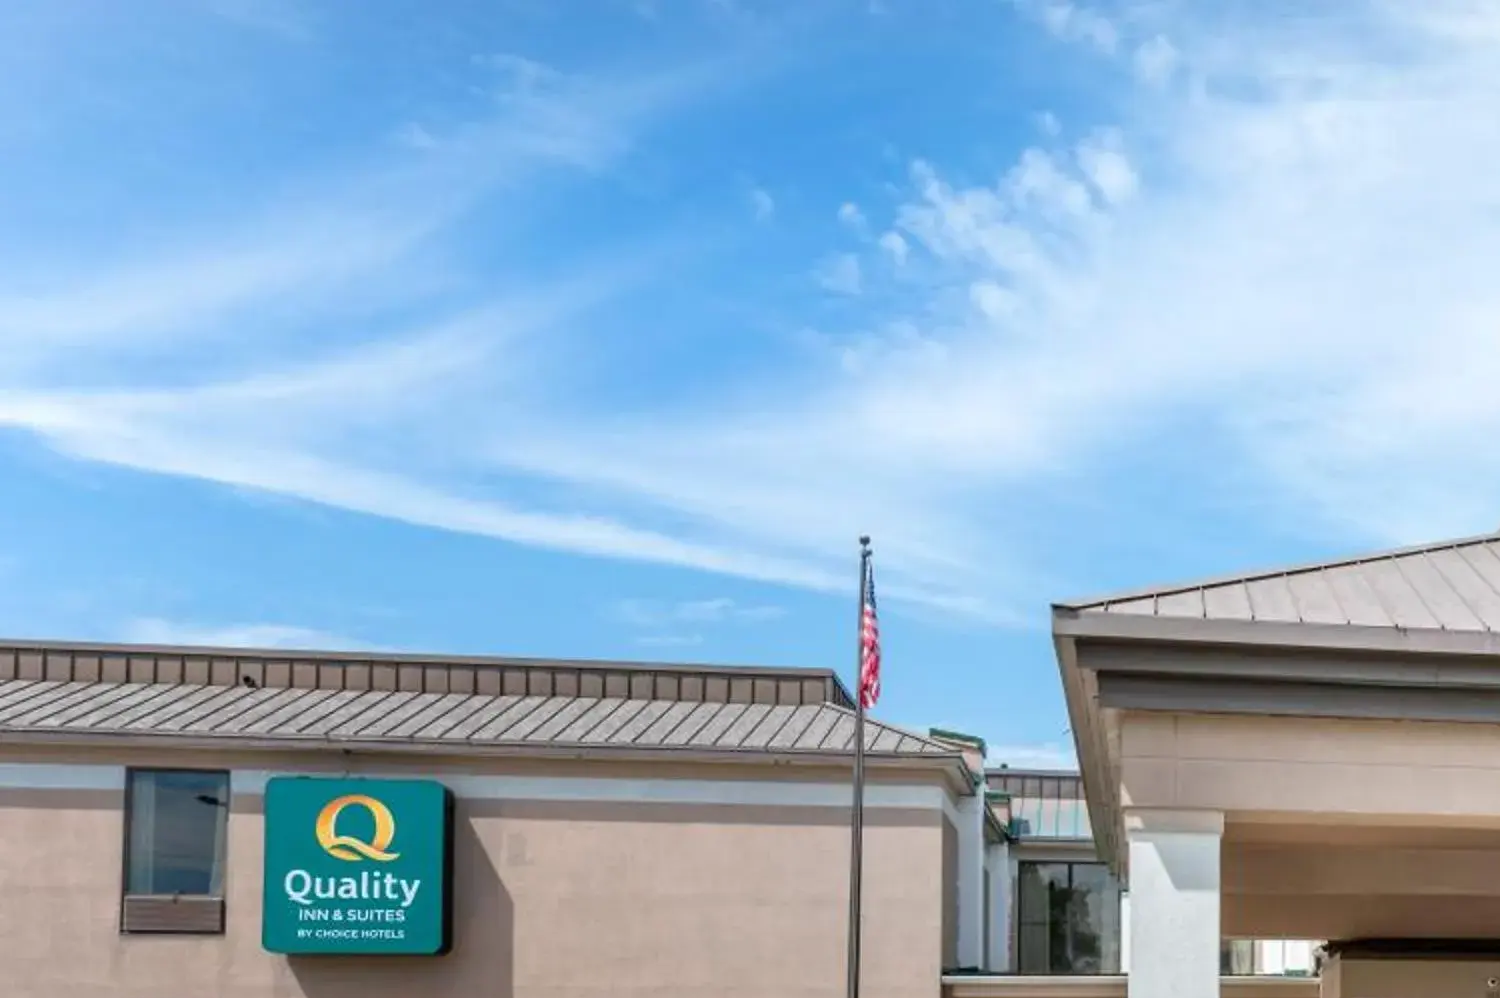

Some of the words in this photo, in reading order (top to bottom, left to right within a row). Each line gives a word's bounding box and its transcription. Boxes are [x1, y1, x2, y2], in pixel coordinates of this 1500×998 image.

[315, 793, 401, 861] Q
[283, 868, 421, 907] Quality
[299, 908, 329, 921] INN
[331, 908, 343, 921] &
[346, 908, 405, 922] SUITES
[297, 928, 313, 938] BY
[315, 929, 359, 939] CHOICE
[361, 929, 405, 939] HOTELS
